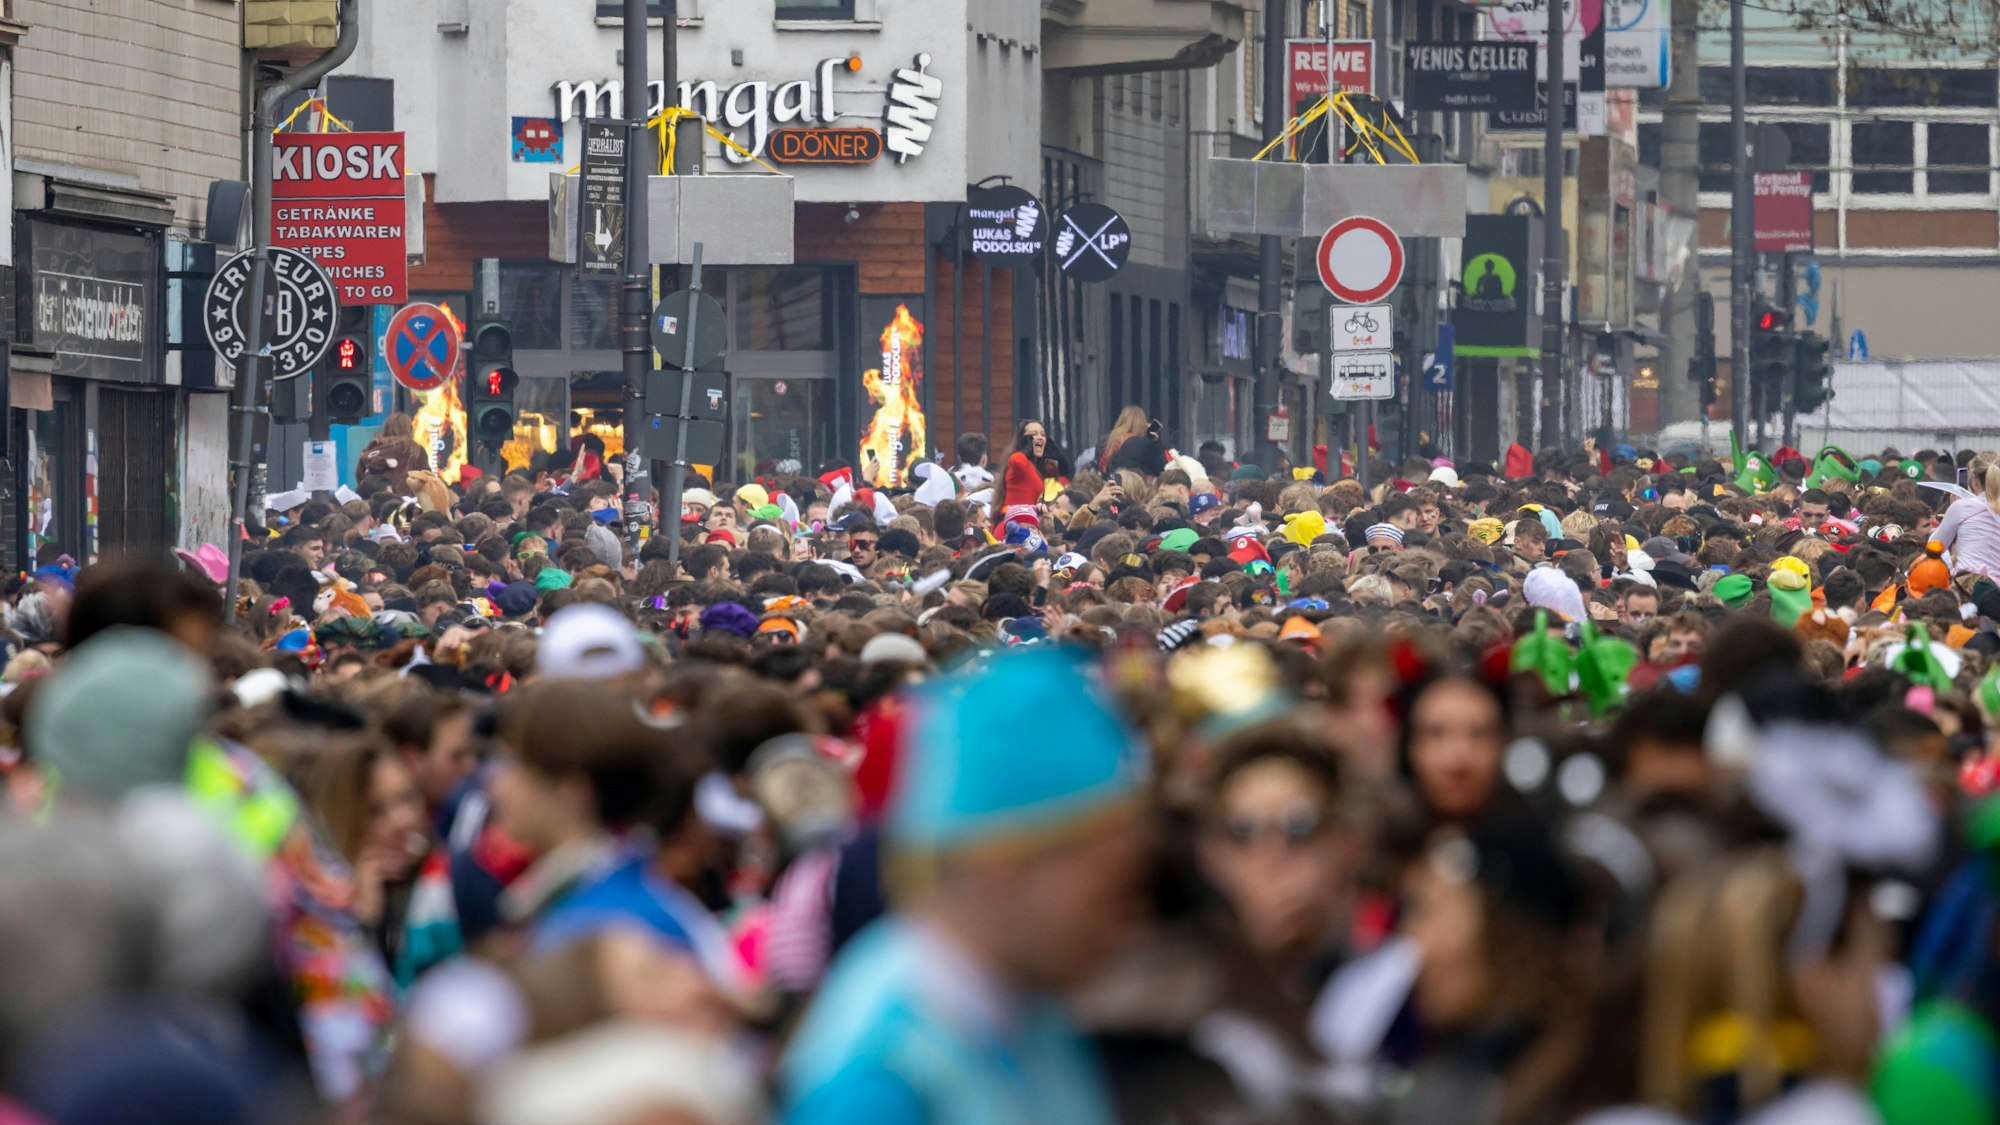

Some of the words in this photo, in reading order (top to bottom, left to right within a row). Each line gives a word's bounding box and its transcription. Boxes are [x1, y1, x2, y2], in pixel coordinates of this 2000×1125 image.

[1294, 50, 1367, 73] REWE
[1411, 46, 1465, 71] VENUS
[1468, 47, 1528, 71] CELLER
[782, 132, 870, 157] DÖNER
[272, 144, 401, 181] KIOSK
[276, 205, 375, 221] GETRÄNKE
[970, 208, 1015, 224] mangal
[276, 225, 402, 239] TABAKWAREN
[973, 228, 1012, 240] LUKAS
[345, 285, 366, 298] TO
[371, 285, 394, 298] GO
